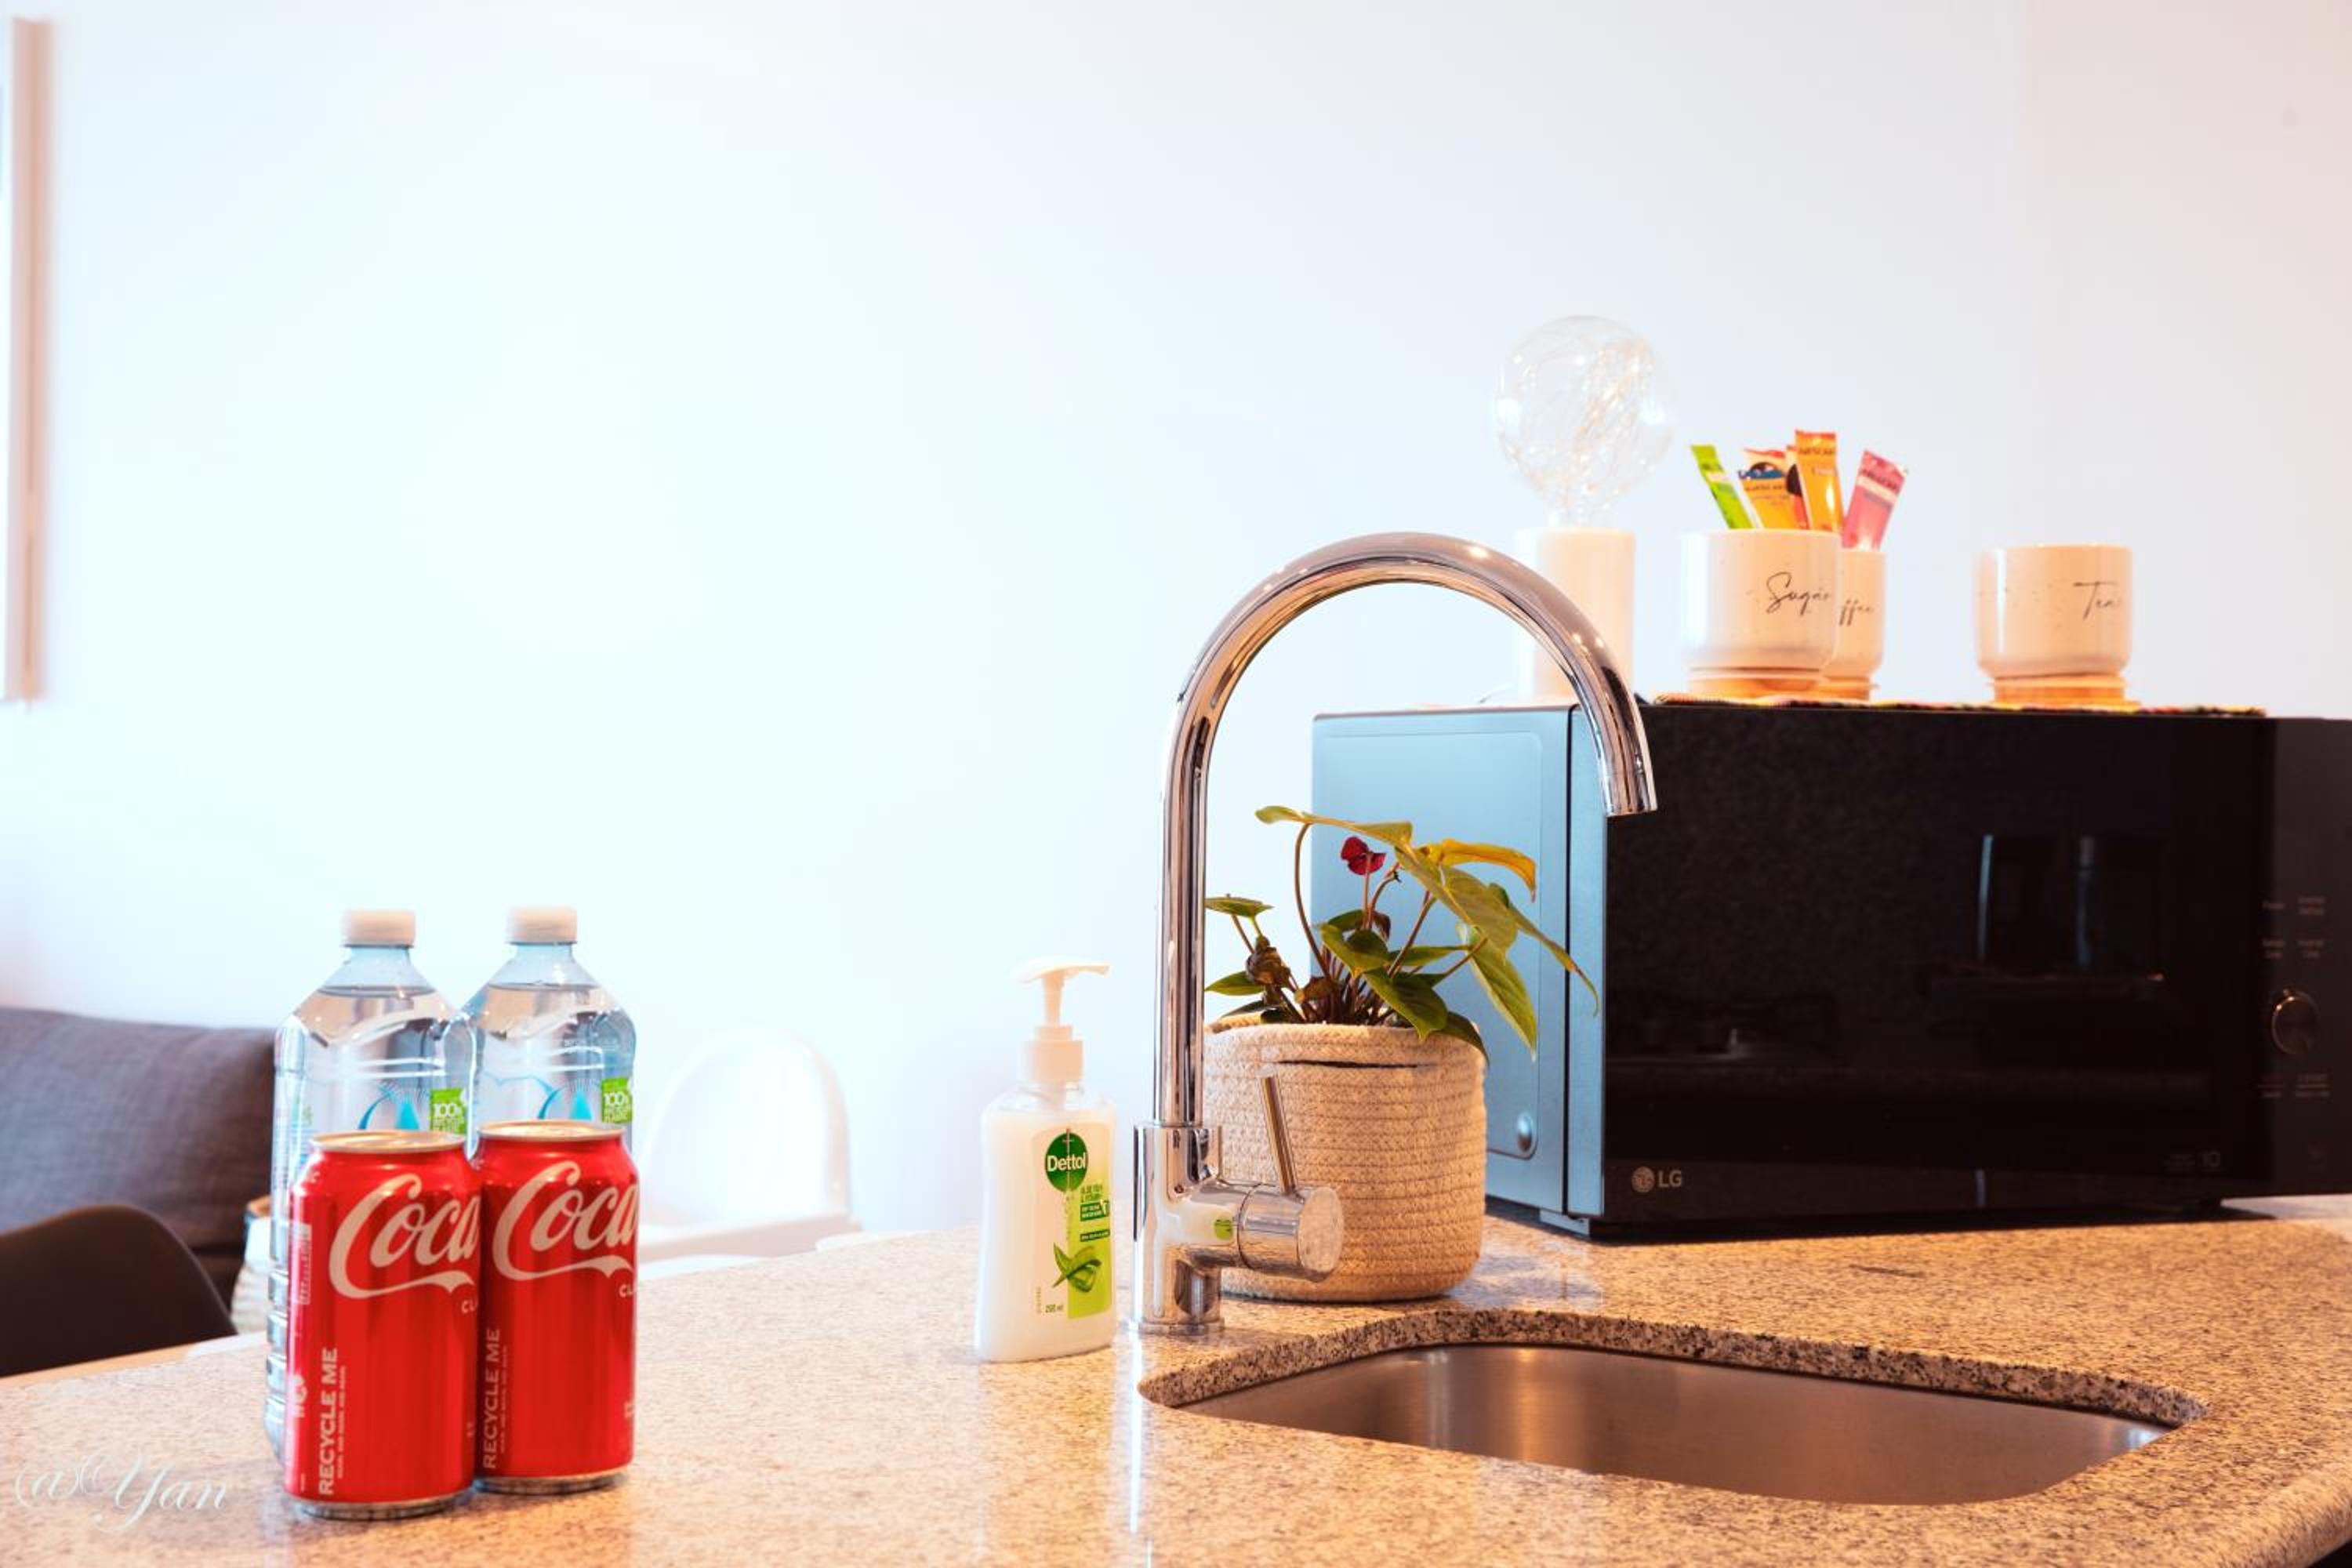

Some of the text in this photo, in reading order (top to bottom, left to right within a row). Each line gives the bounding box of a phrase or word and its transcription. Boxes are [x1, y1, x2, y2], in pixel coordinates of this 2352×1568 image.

[492, 1160, 639, 1281] Coca
[1047, 1152, 1086, 1172] Dettol
[1657, 1169, 1682, 1189] LG
[328, 1173, 481, 1300] Coca
[318, 1346, 338, 1496] RECYCLE ME
[484, 1328, 500, 1468] RECYCLE ME
